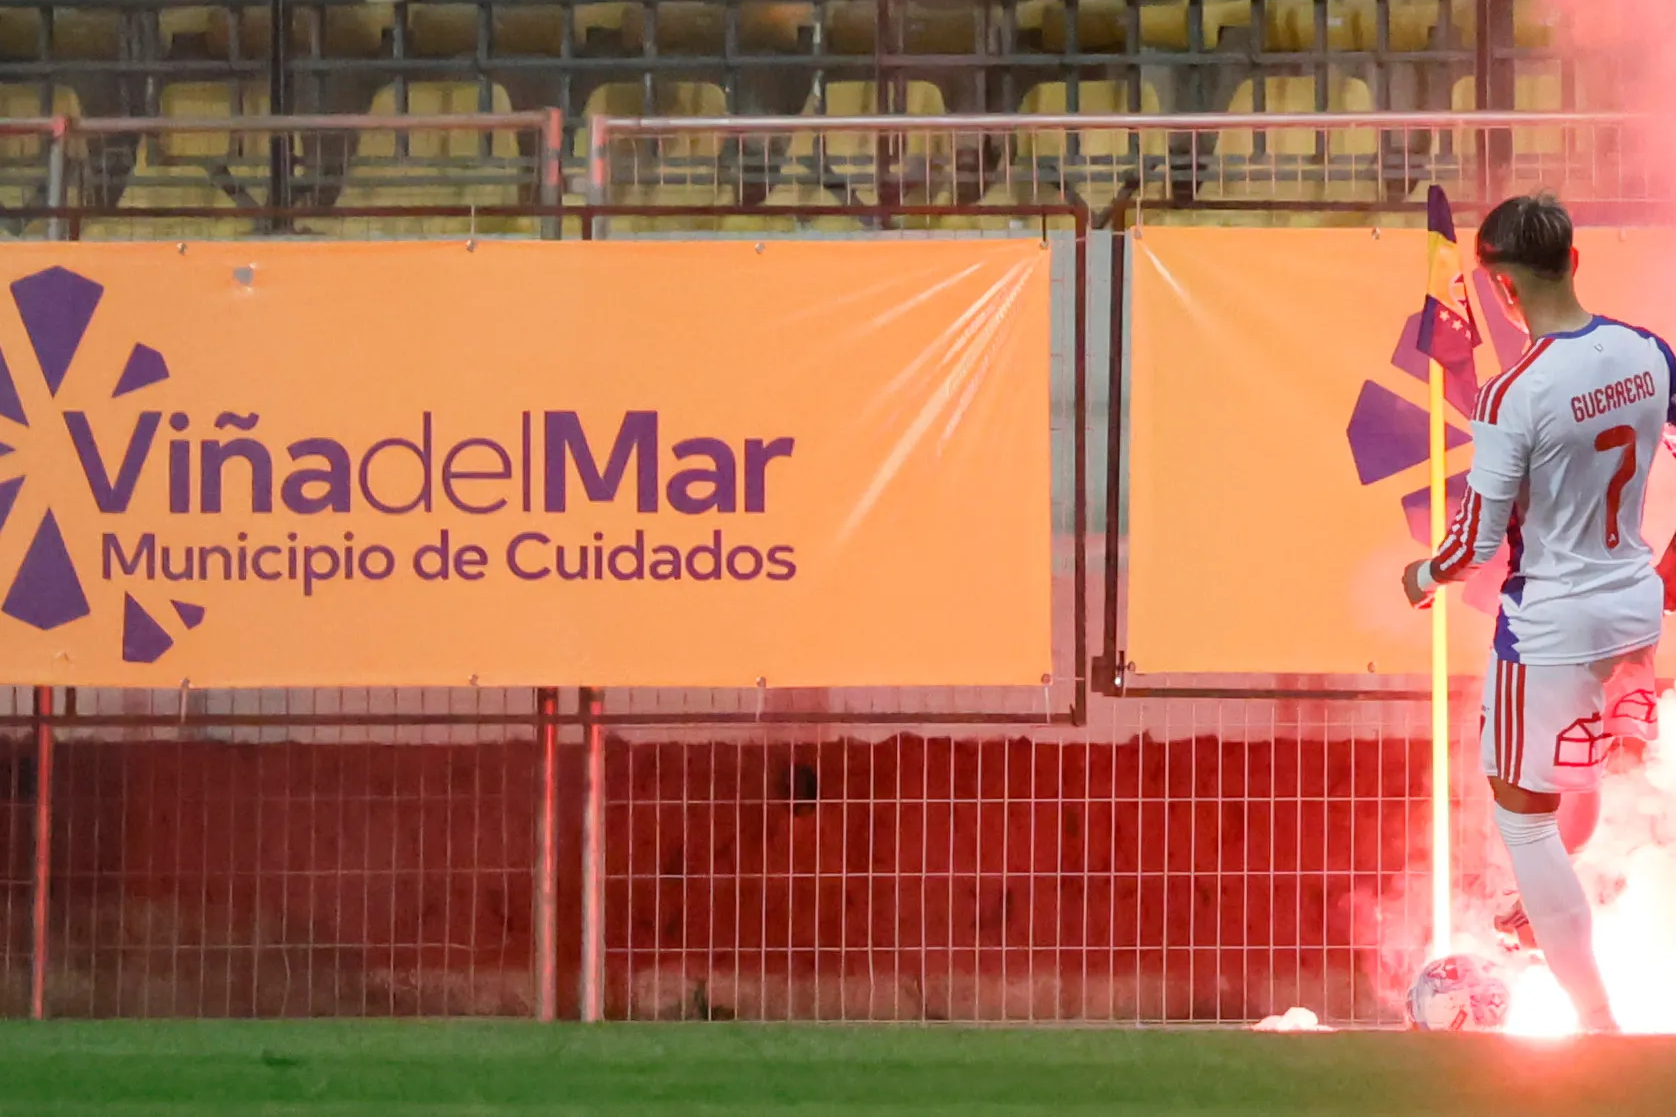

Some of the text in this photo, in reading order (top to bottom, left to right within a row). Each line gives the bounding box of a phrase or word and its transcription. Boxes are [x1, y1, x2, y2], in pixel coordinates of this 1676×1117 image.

[1571, 370, 1656, 423] GUERRERO
[63, 410, 796, 516] ViñadelMar
[1594, 424, 1637, 549] 7
[101, 528, 797, 596] Municipio de Cuidados
